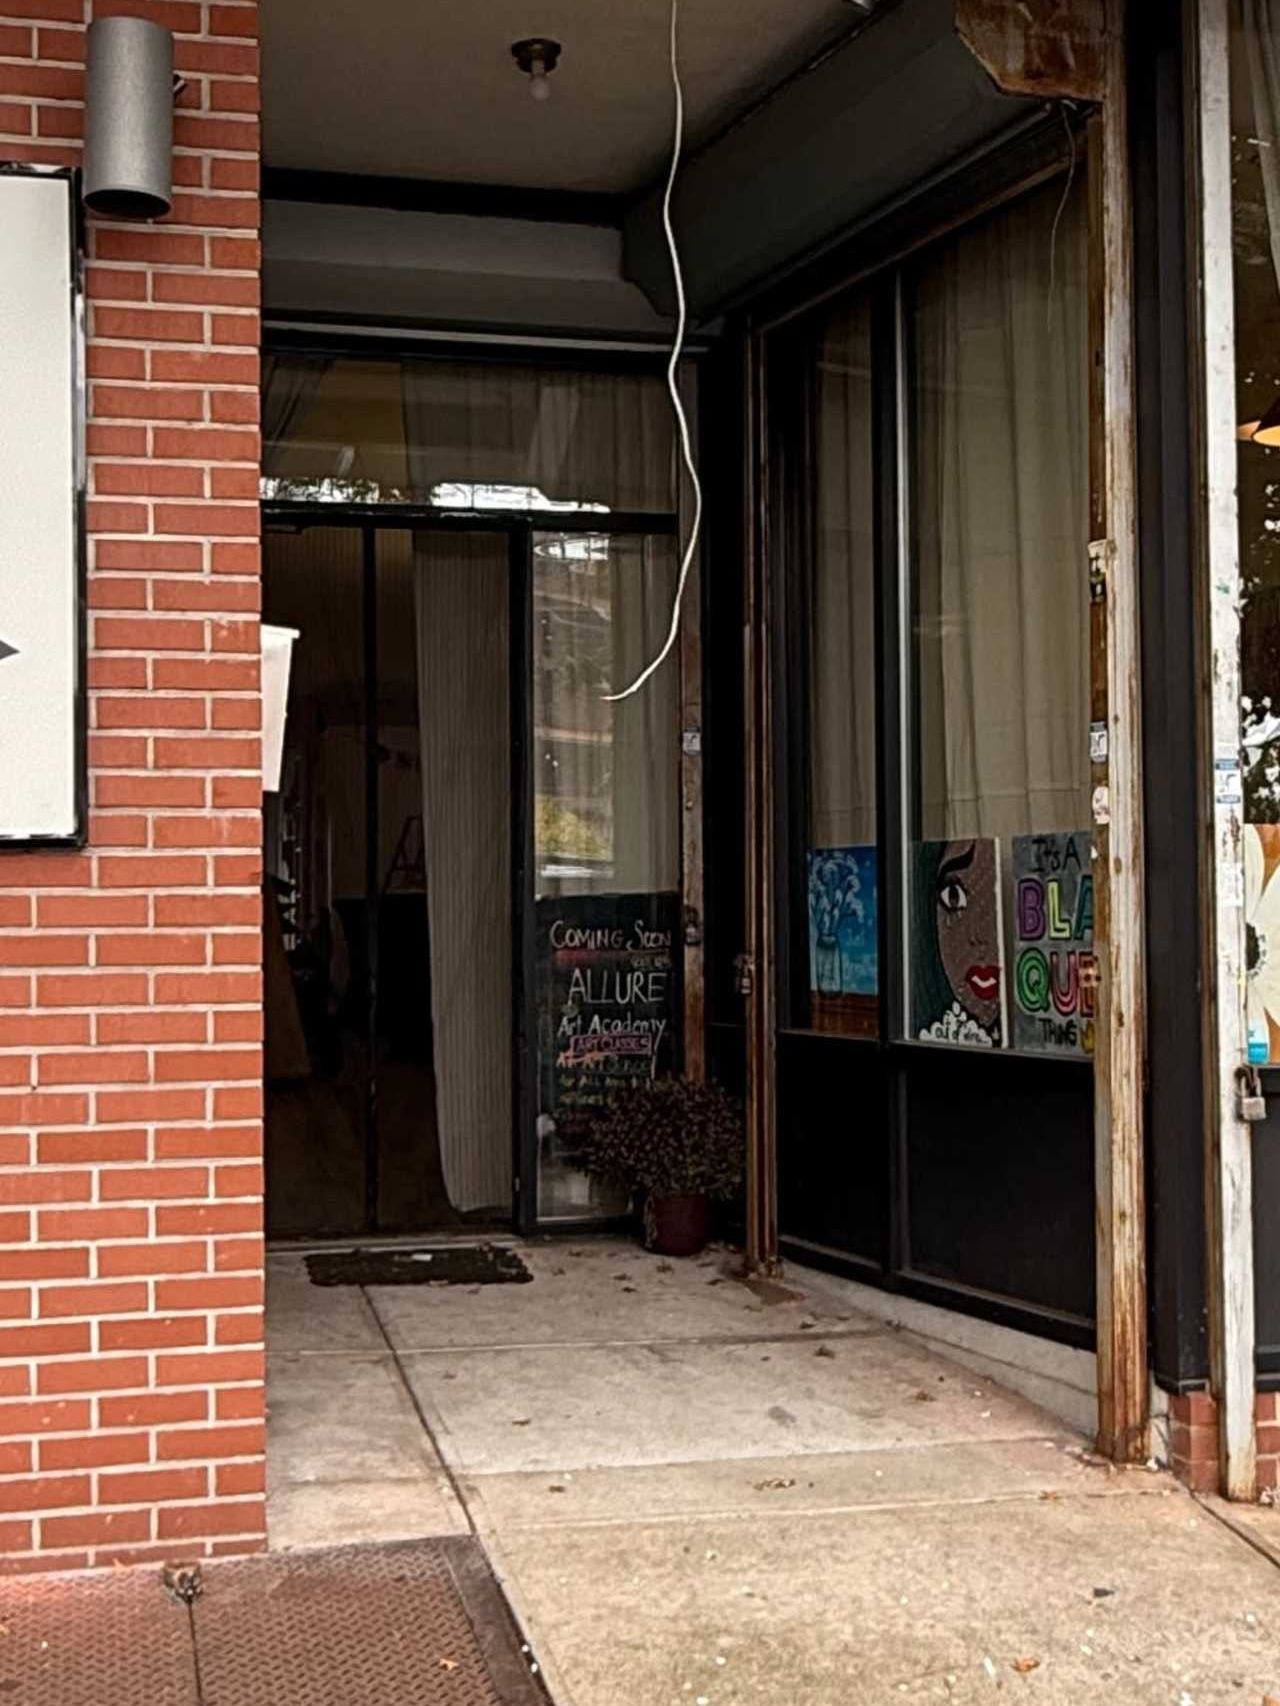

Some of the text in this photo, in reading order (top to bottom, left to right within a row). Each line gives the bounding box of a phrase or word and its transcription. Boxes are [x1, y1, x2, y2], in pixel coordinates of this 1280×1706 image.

[569, 967, 668, 1005] ALLURE
[557, 1010, 668, 1058] Art Academy
